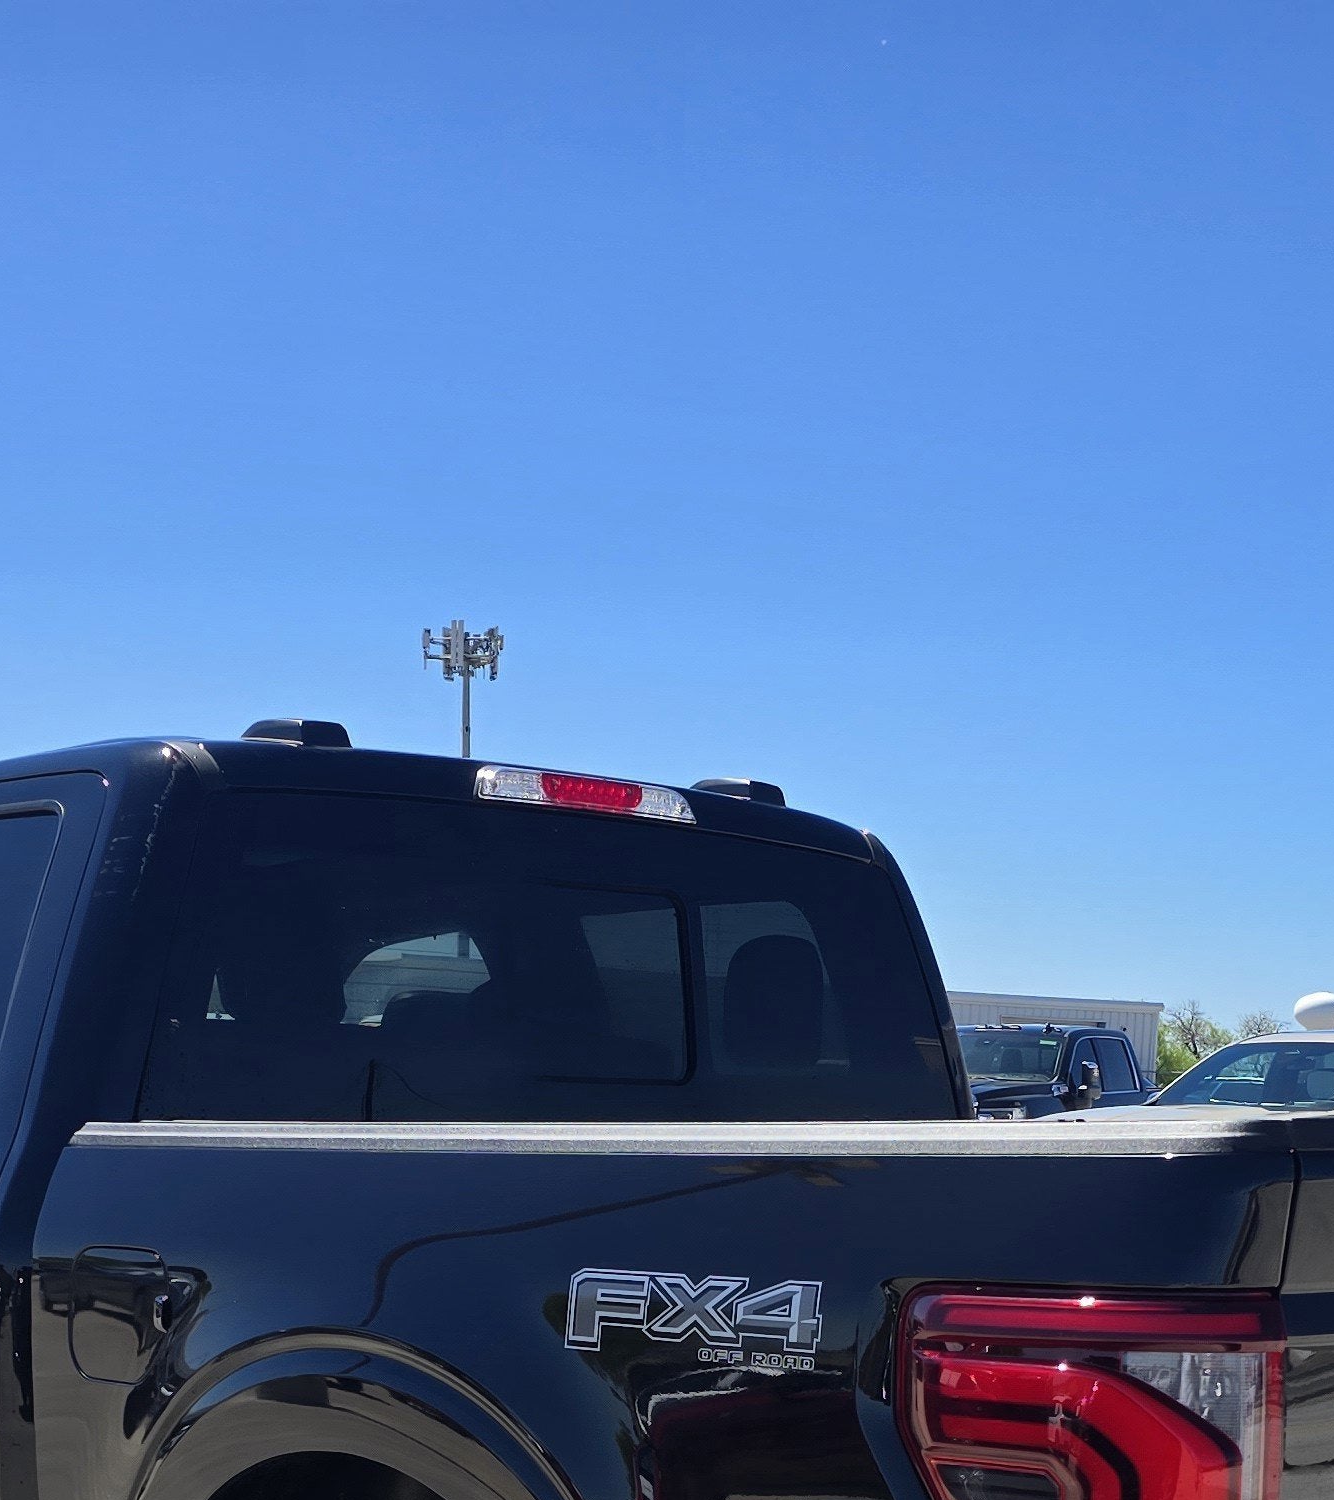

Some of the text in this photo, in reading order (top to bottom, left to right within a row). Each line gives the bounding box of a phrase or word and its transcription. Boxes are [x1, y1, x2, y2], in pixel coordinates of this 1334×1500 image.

[564, 1268, 823, 1354] FX4
[698, 1348, 815, 1371] OFF ROAD
